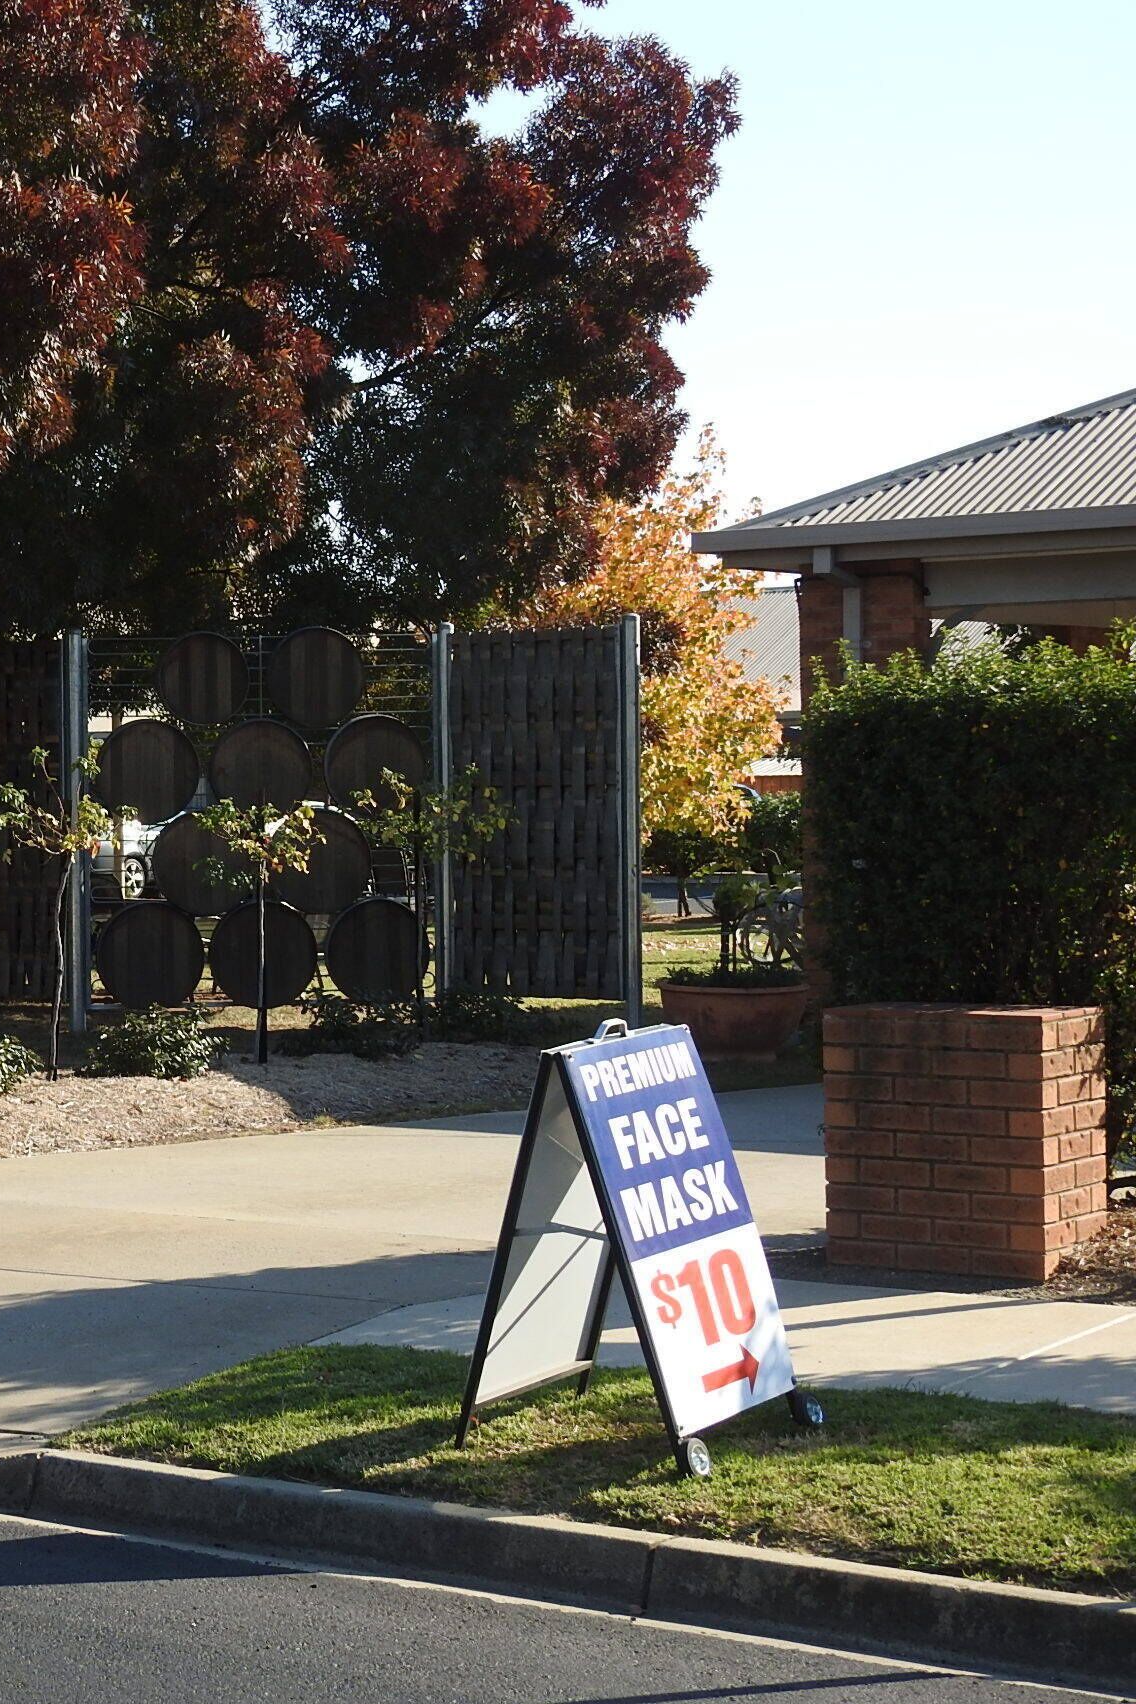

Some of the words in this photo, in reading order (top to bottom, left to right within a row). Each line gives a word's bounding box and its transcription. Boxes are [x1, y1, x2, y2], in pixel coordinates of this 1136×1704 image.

[579, 1041, 697, 1102] PREMIUM
[608, 1097, 710, 1170] FACE
[619, 1160, 739, 1242] MASK
[650, 1248, 757, 1346] $10
